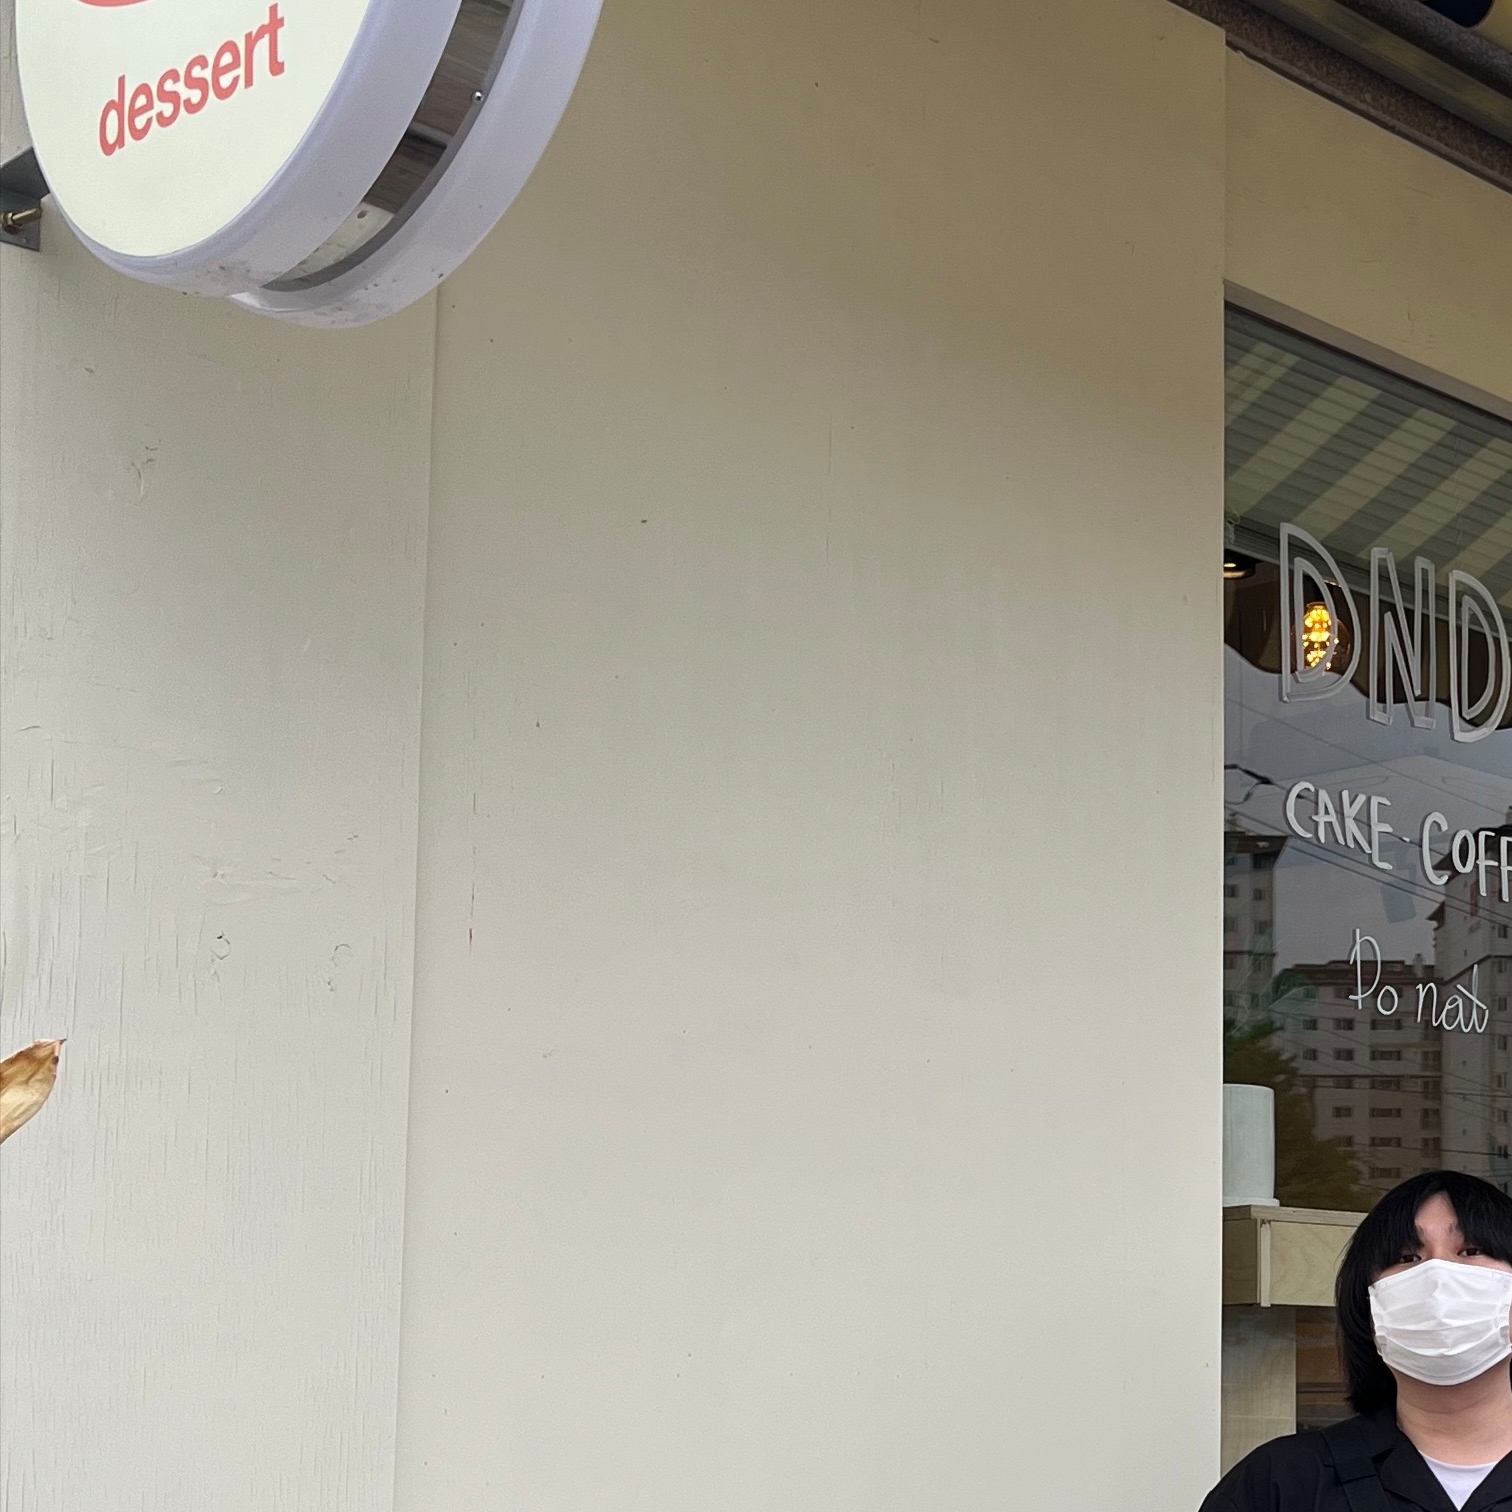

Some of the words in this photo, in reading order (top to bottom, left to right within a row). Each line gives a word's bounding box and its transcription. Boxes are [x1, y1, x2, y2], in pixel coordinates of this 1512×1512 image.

[98, 3, 285, 157] dessert
[1279, 521, 1512, 743] DND
[1348, 928, 1399, 1016] Do
[1415, 964, 1490, 1034] not
